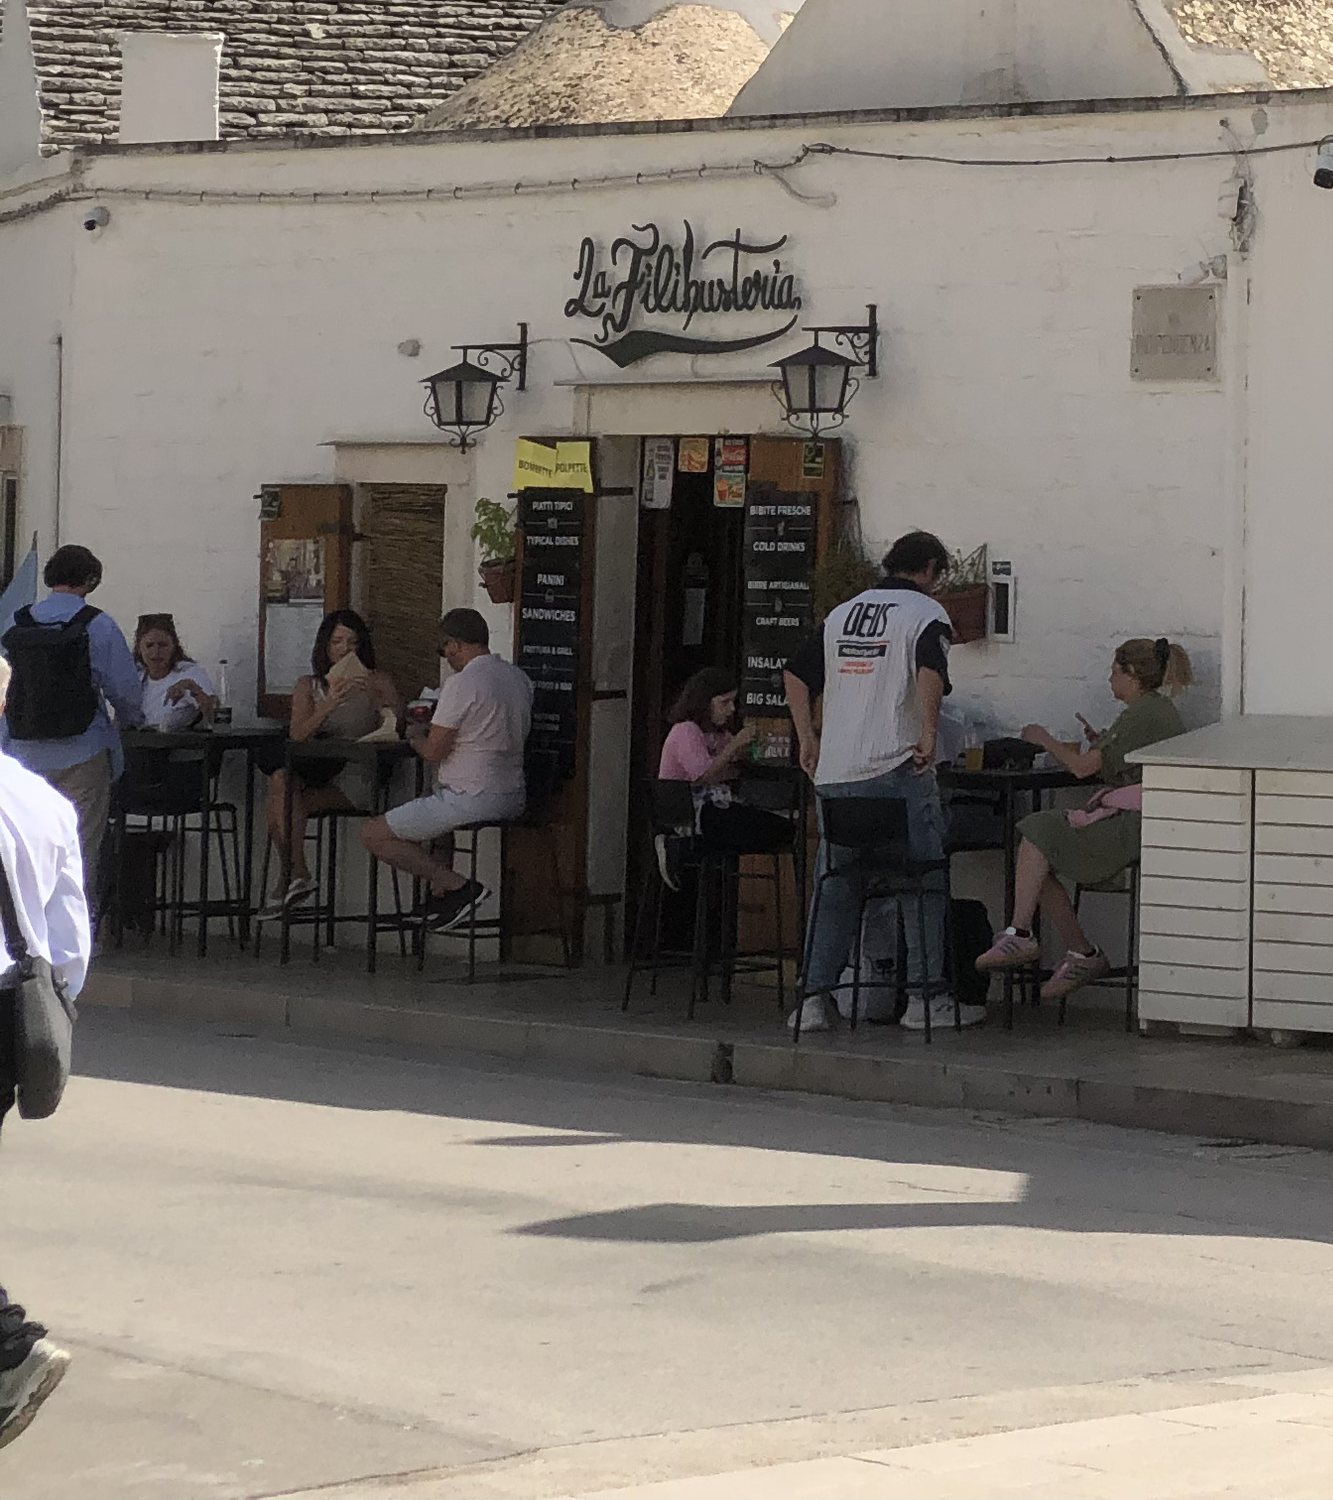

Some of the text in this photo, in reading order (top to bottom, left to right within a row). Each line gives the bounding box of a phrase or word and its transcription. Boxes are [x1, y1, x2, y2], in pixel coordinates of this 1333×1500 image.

[564, 219, 801, 343] La Filibusteria
[555, 462, 588, 474] POLPETTE
[532, 501, 573, 511] PIATTI TIPICI
[749, 505, 812, 516] BIBITE FRESCHE
[526, 536, 579, 546] TYPICAL DISHES
[752, 541, 806, 552] COLD DRINKS
[537, 573, 565, 586] PANINI
[521, 608, 576, 622] SANDWICHES
[755, 616, 800, 626] CRAFT BEERS
[842, 602, 899, 637] DEUS
[747, 656, 788, 670] INSALAT
[746, 692, 789, 706] BIG SALA
